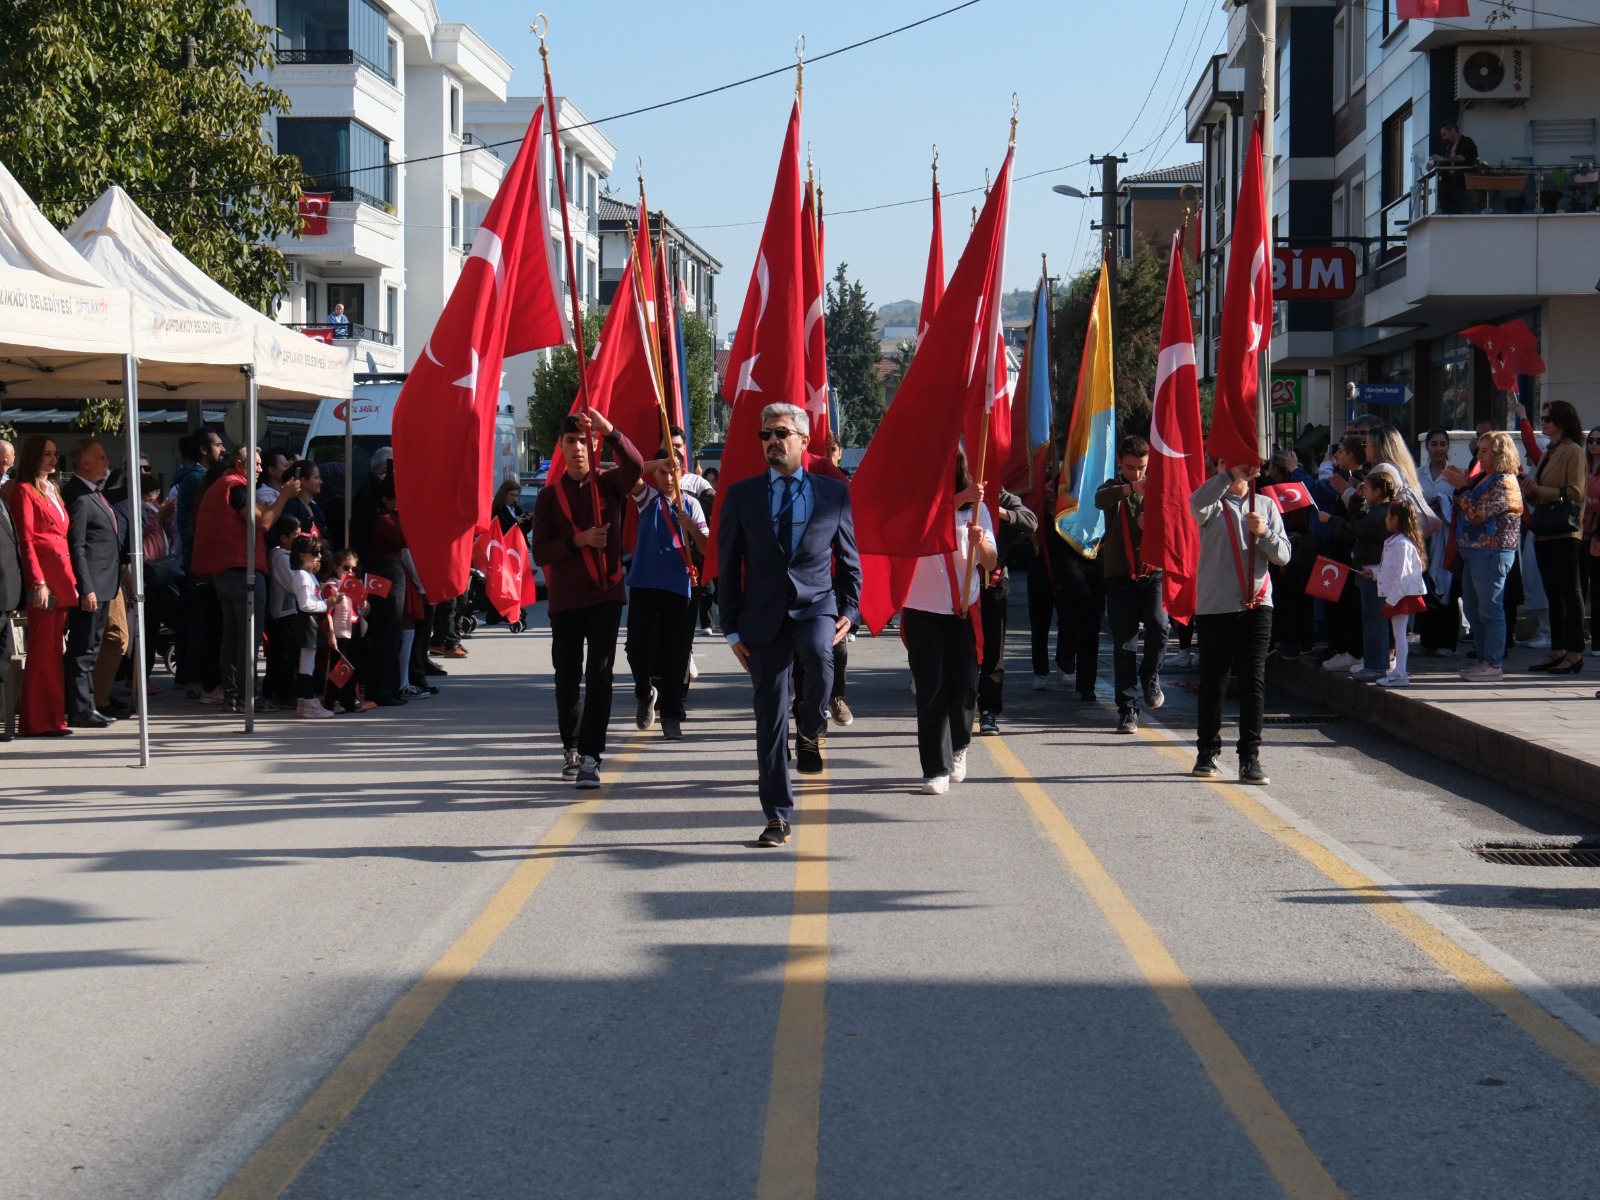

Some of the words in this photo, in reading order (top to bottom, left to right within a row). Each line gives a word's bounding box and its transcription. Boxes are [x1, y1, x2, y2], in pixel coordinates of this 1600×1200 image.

[1512, 48, 1523, 82] arçelik
[1272, 249, 1345, 290] BİM
[29, 293, 73, 316] BELEDİYESİ
[165, 316, 193, 336] ÇİFTLİKKÖY
[194, 319, 222, 334] BELEDİYESİ
[1365, 387, 1384, 395] Hürriyet
